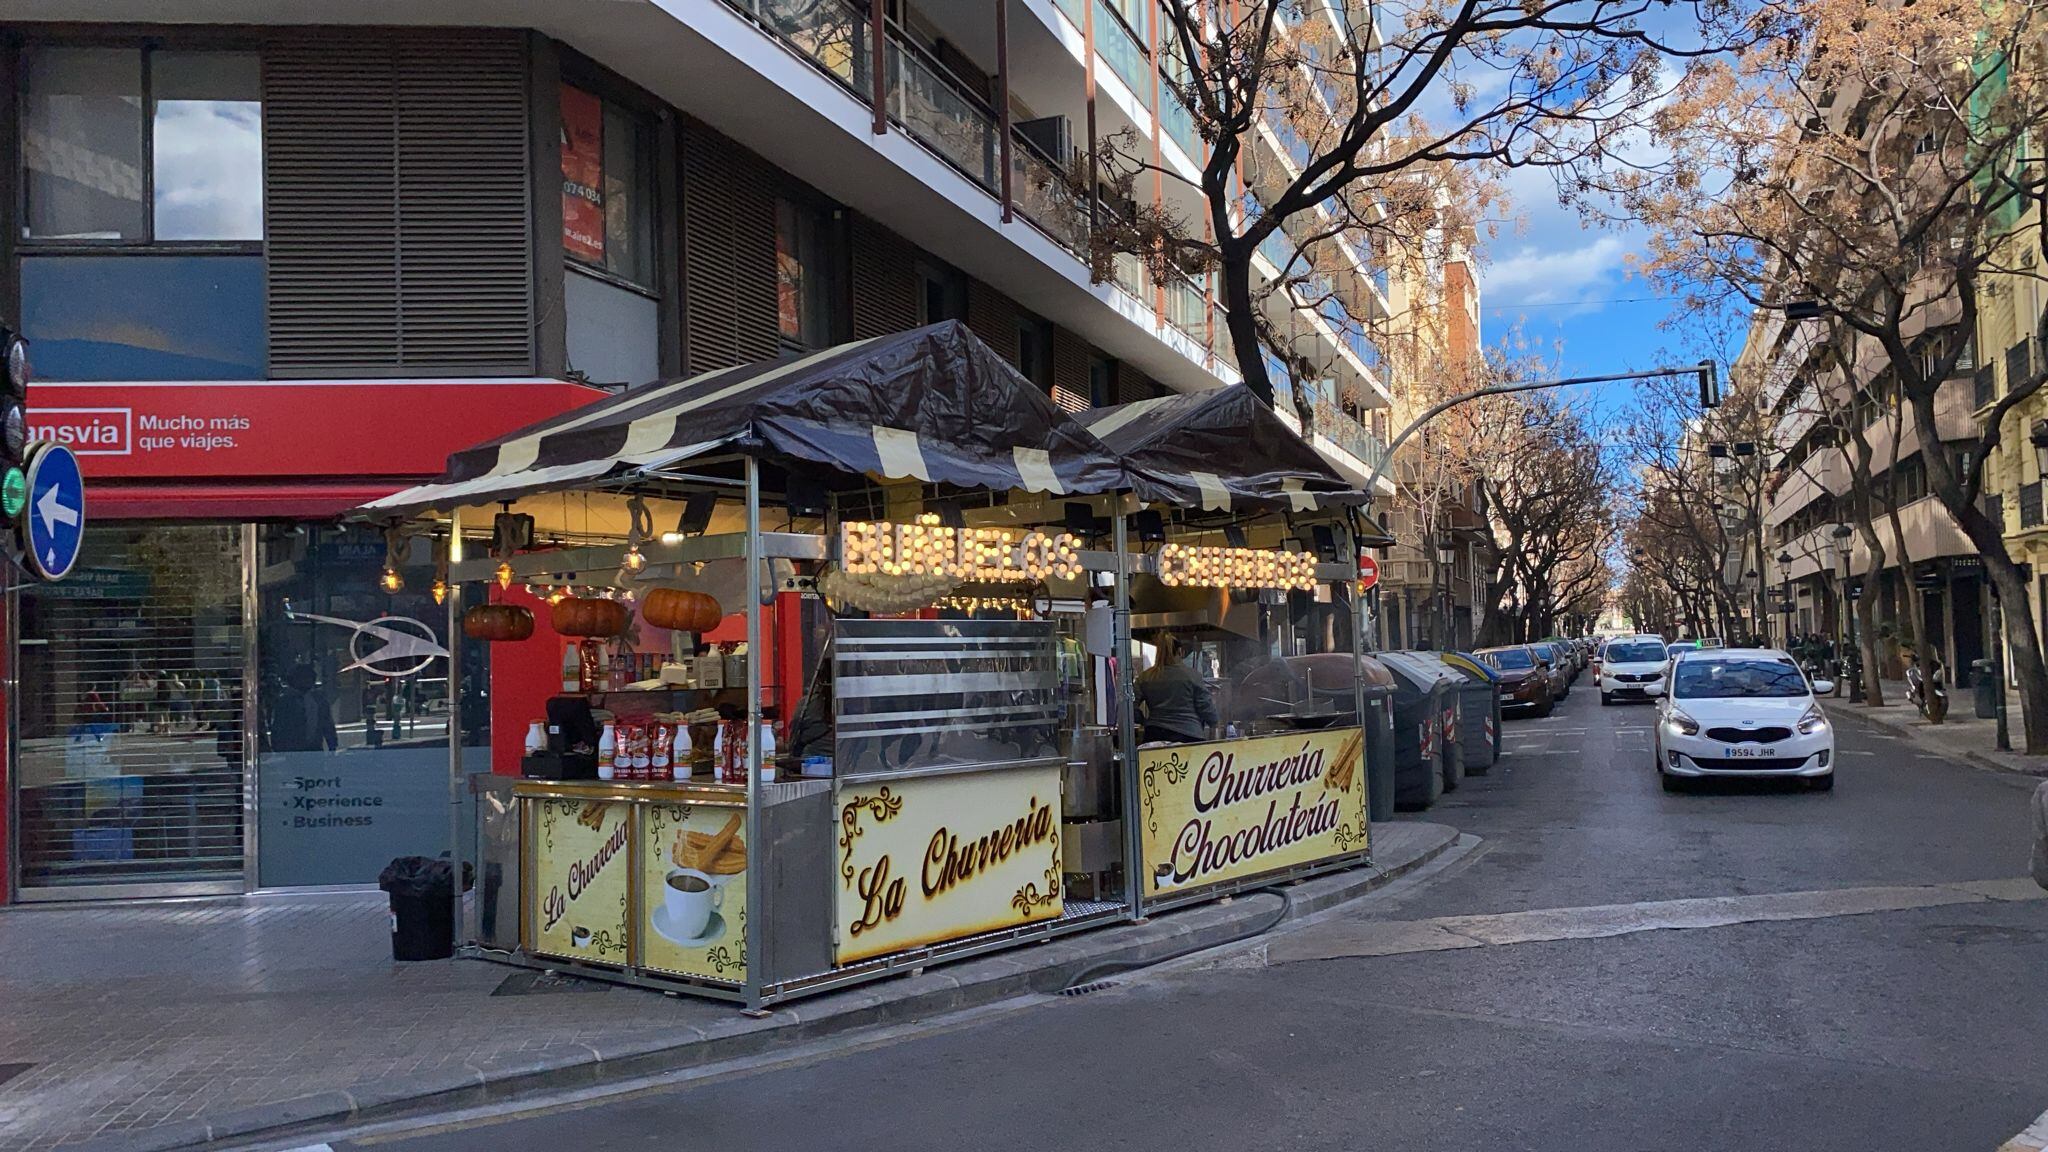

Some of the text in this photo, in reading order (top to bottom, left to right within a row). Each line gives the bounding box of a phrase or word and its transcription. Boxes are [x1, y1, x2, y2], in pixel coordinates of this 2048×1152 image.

[139, 414, 250, 430] Mucho más
[139, 432, 239, 451] que viajes.
[841, 512, 1083, 581] BUÑUELOS
[1158, 543, 1318, 591] CHURROS
[1731, 748, 1776, 757] 9594 JHR
[293, 776, 341, 792] Sport
[1193, 740, 1326, 815] Churrería
[293, 794, 384, 811] Xperience
[293, 813, 373, 828] Business
[1170, 791, 1341, 884] Chocolatería
[543, 885, 566, 932] La
[568, 820, 628, 901] Churrería
[850, 854, 908, 936] La
